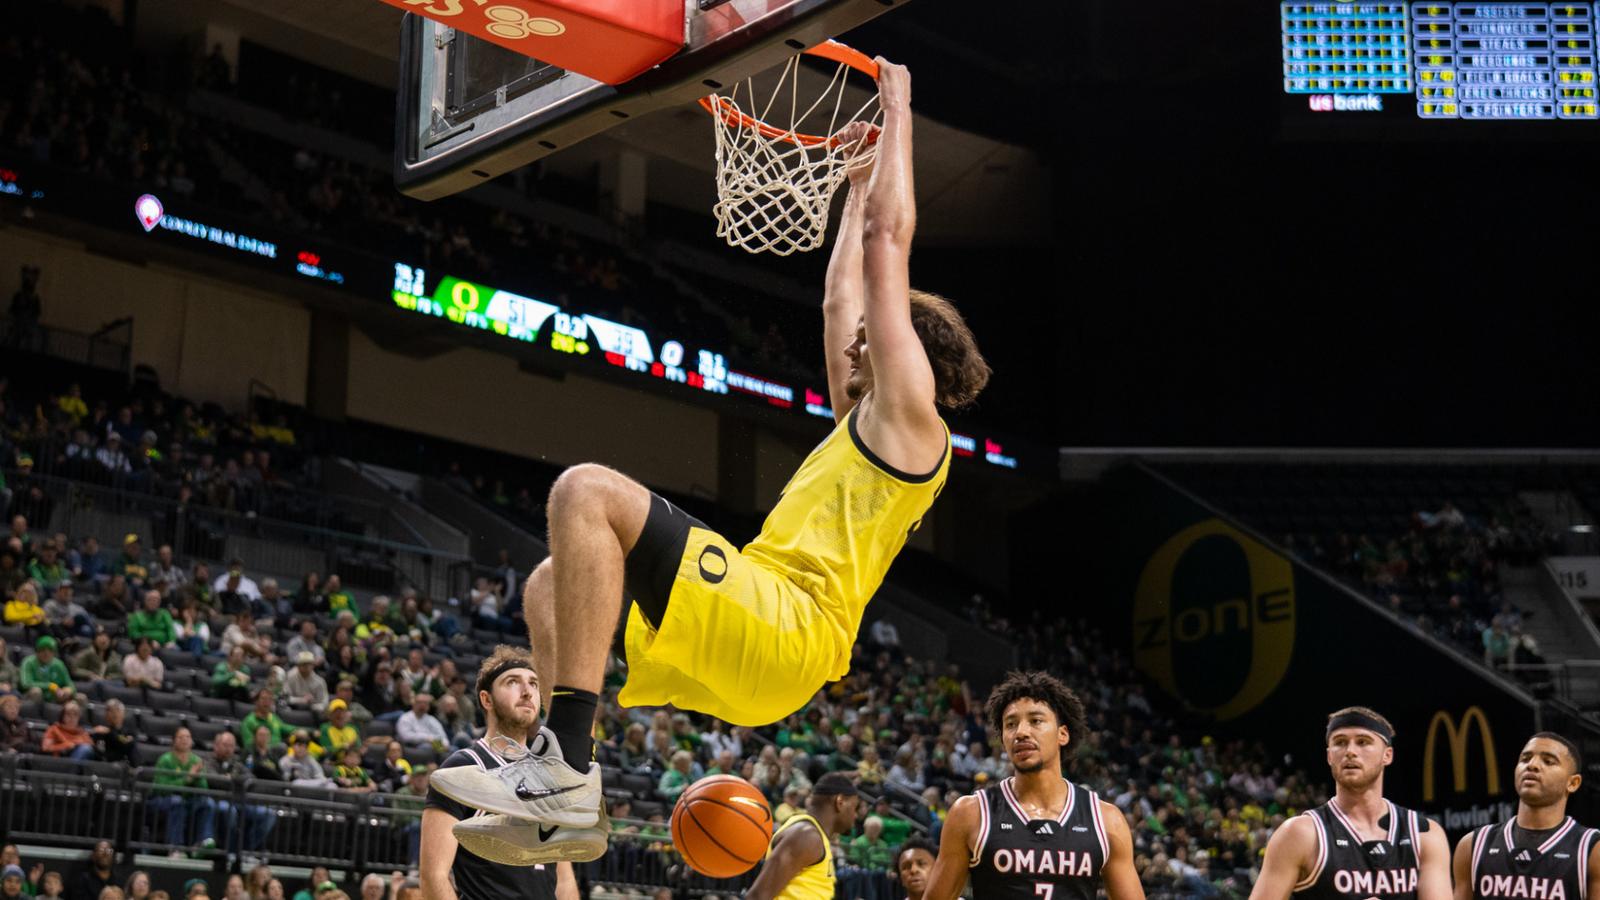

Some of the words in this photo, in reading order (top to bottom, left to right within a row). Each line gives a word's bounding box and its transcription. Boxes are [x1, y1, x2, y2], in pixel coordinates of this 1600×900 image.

[1474, 6, 1526, 17] ASSISTS
[1467, 22, 1536, 35] TURNOVERS
[1479, 38, 1526, 50] STEALS
[1472, 54, 1536, 67] REBOUNDS
[1309, 95, 1333, 111] us
[1334, 93, 1382, 111] bank
[993, 848, 1093, 877] OMAHA
[1334, 868, 1418, 894] OMAHA
[1480, 874, 1566, 900] OMAHA
